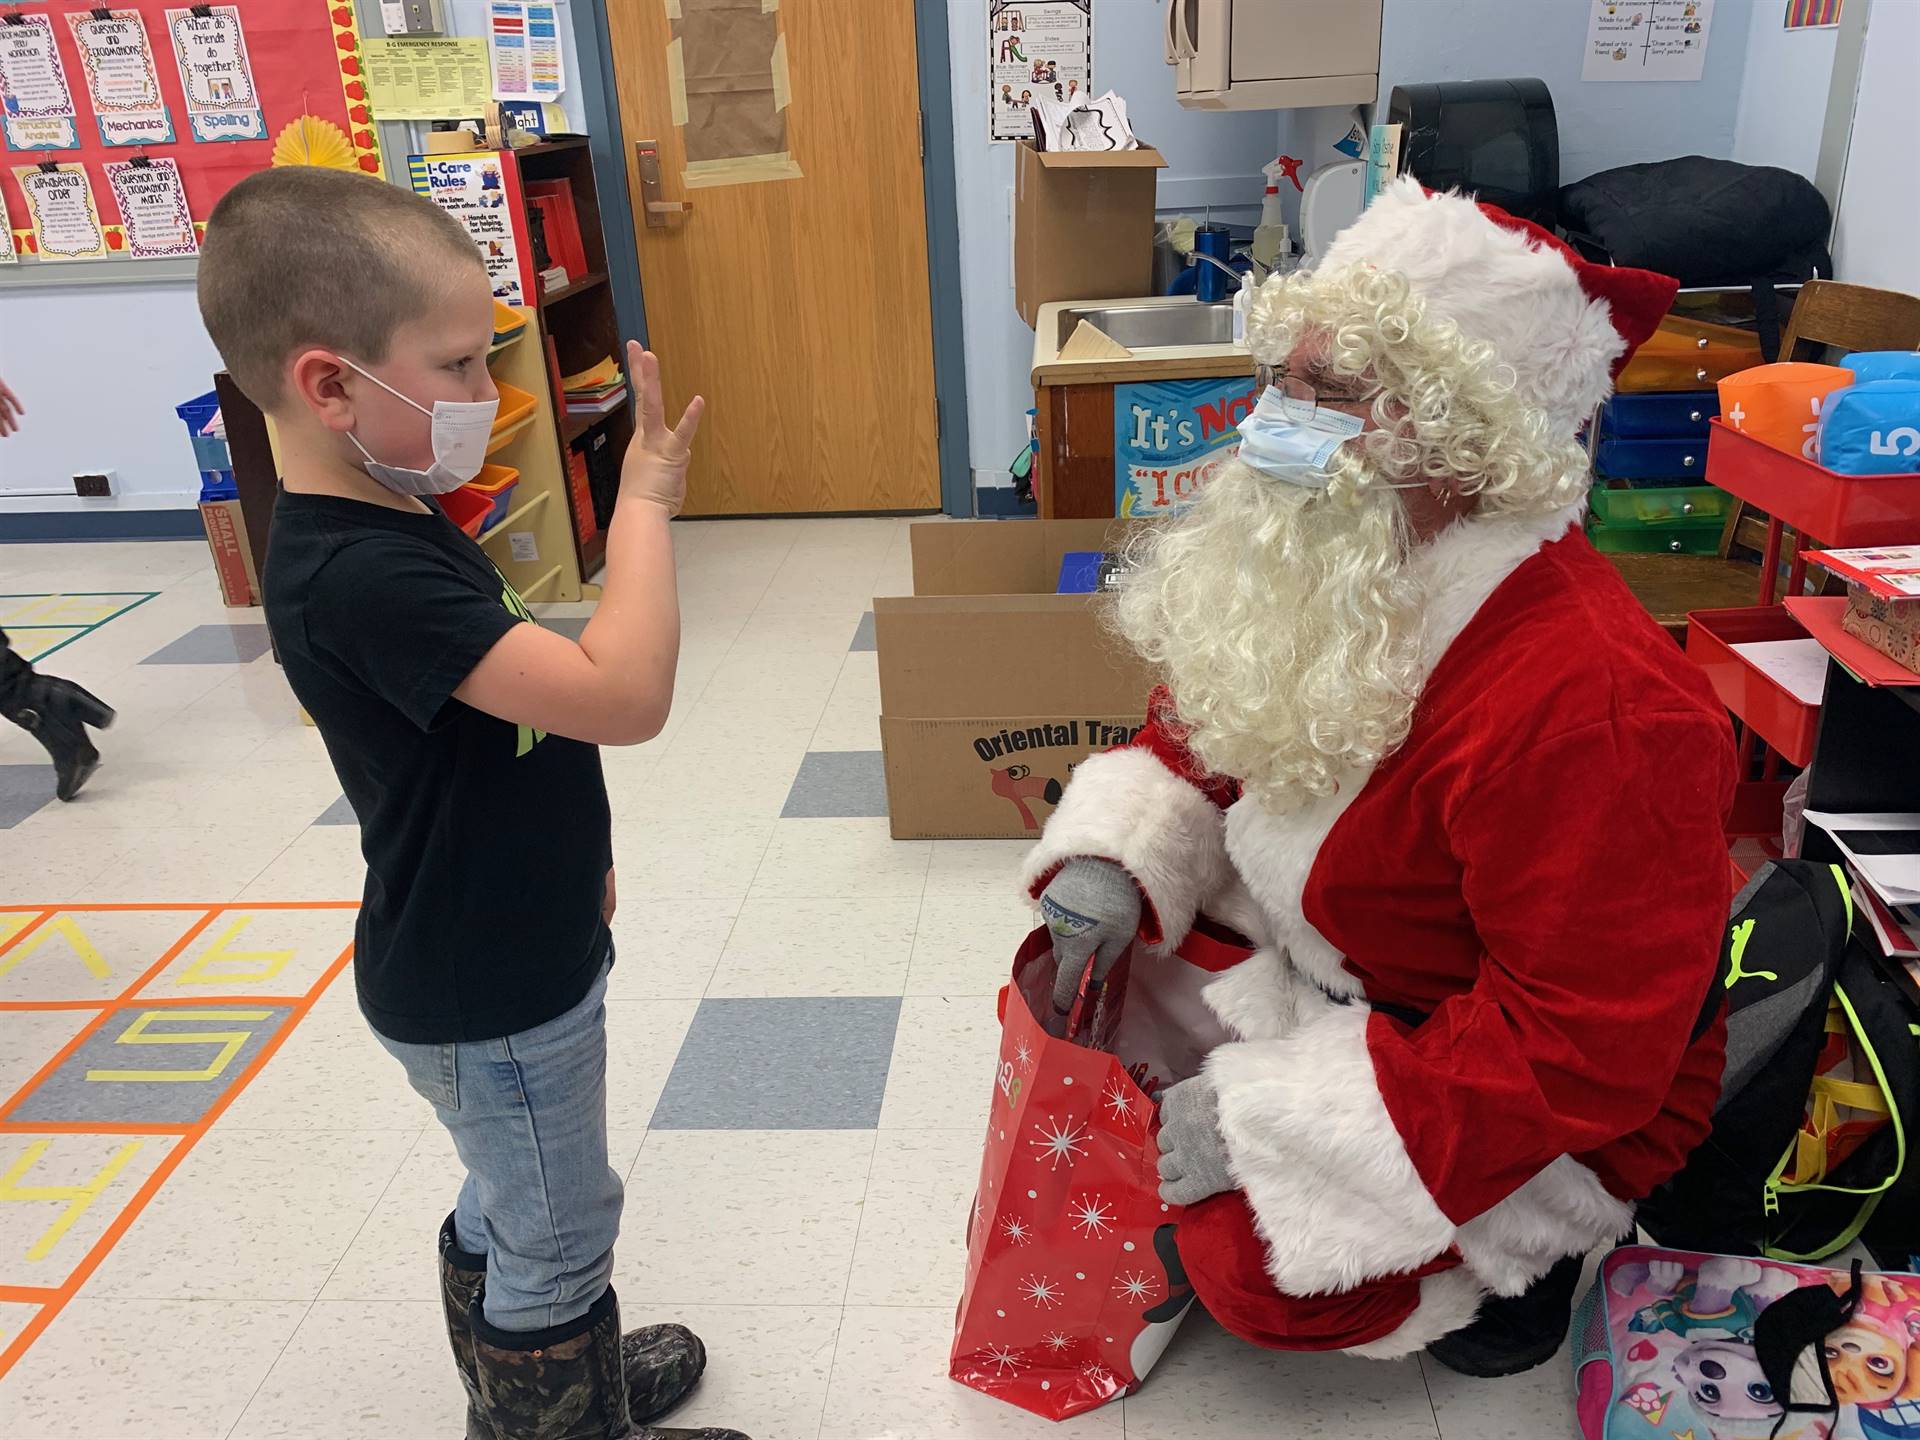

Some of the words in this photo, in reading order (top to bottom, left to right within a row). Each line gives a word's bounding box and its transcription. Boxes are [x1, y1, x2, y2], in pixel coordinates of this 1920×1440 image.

[184, 18, 211, 31] What
[214, 18, 226, 29] do
[192, 33, 226, 45] friends
[206, 47, 218, 58] do
[193, 60, 237, 78] together?
[107, 119, 164, 132] Mechanics
[203, 113, 250, 129] Spelling
[427, 161, 472, 175] I-Care
[429, 174, 467, 188] Rules
[1129, 403, 1195, 451] It's
[1193, 389, 1258, 440] NO
[213, 507, 238, 557] SMALL
[973, 720, 1079, 763] Oriental
[84, 1010, 275, 1082] 5
